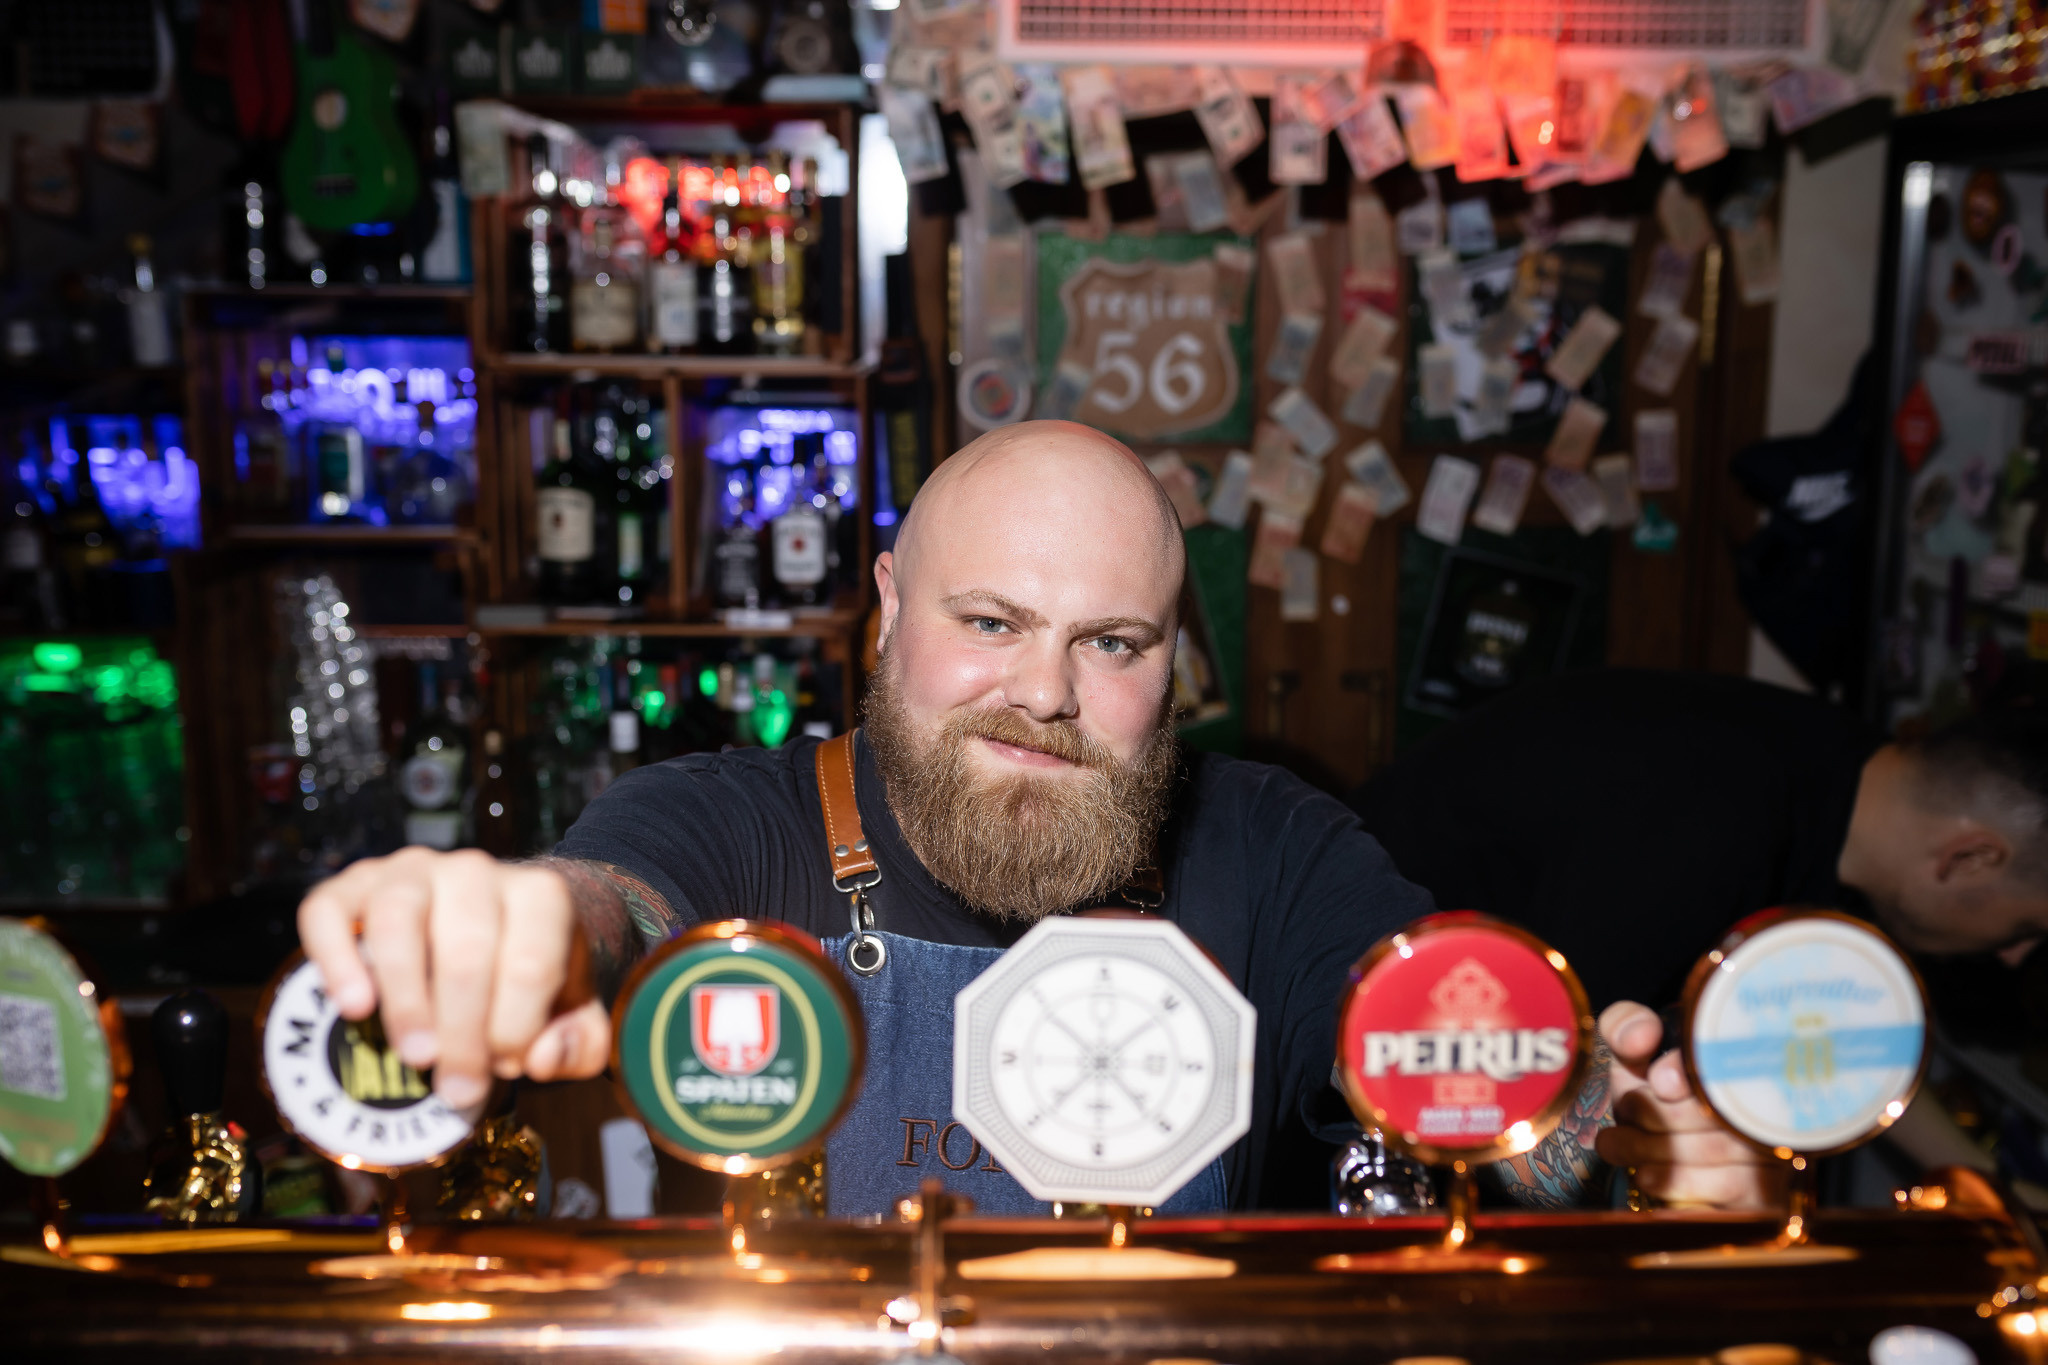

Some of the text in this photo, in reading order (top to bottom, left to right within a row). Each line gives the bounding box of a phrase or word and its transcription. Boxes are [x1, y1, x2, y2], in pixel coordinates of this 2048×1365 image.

[1084, 288, 1214, 330] region
[1095, 331, 1205, 416] 56
[1362, 1027, 1571, 1084] PETRUS
[675, 1075, 797, 1104] SPATEN
